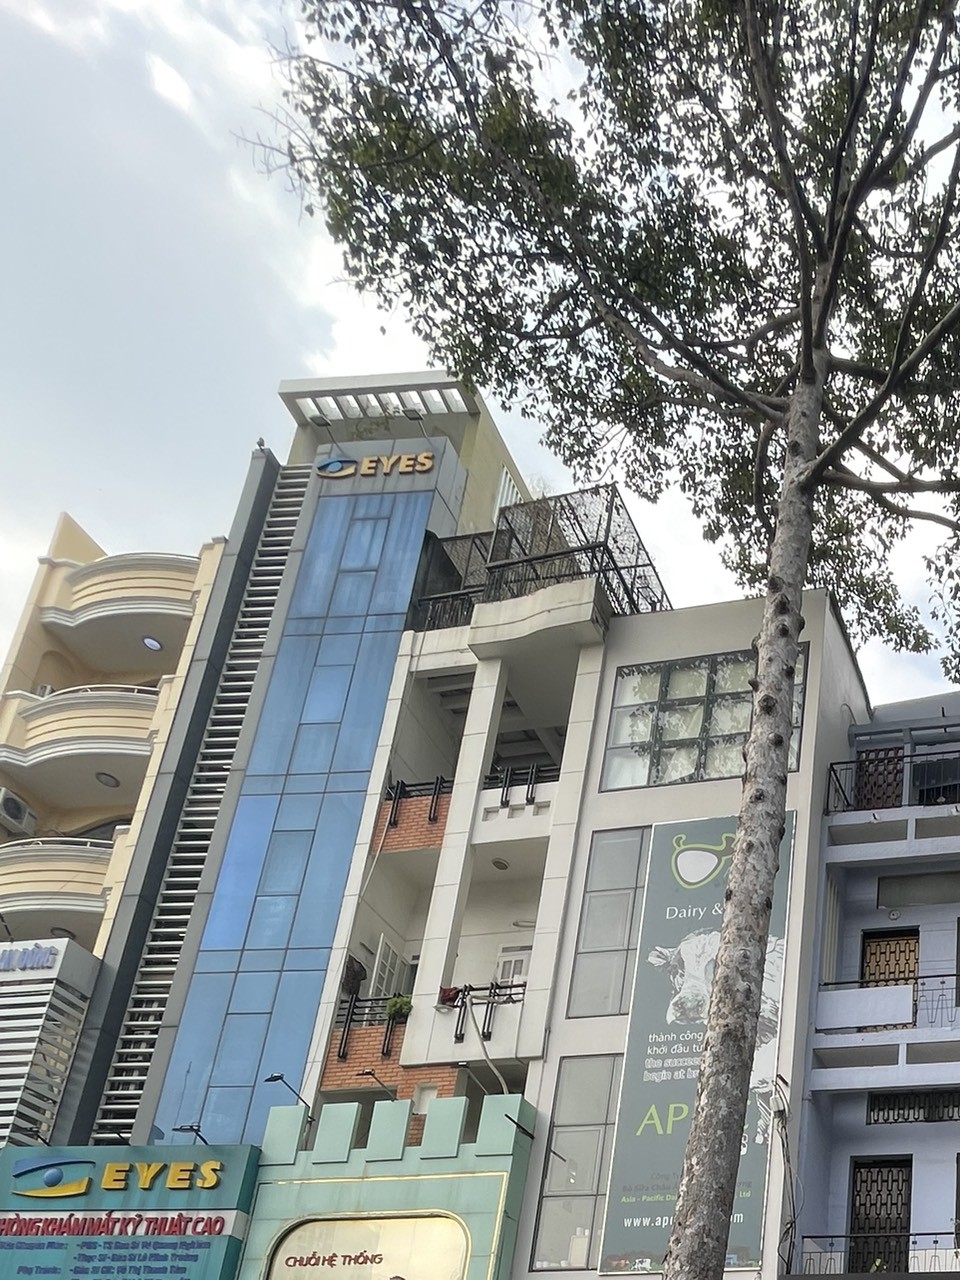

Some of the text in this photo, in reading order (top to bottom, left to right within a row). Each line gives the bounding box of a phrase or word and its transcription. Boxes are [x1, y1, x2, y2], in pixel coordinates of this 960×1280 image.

[360, 452, 434, 476] EYES
[666, 903, 723, 920] Dairy &
[649, 1030, 703, 1042] thành công
[101, 1160, 222, 1190] EYES
[642, 1193, 664, 1202] Pacific
[0, 1213, 42, 1236] HÒNG
[40, 1213, 86, 1235] KHÁM
[87, 1210, 119, 1235] MẮT
[144, 1213, 191, 1235] THUẬT
[192, 1217, 225, 1235] CAO
[285, 1250, 383, 1268] CHUỖI HỆ THỐNG
